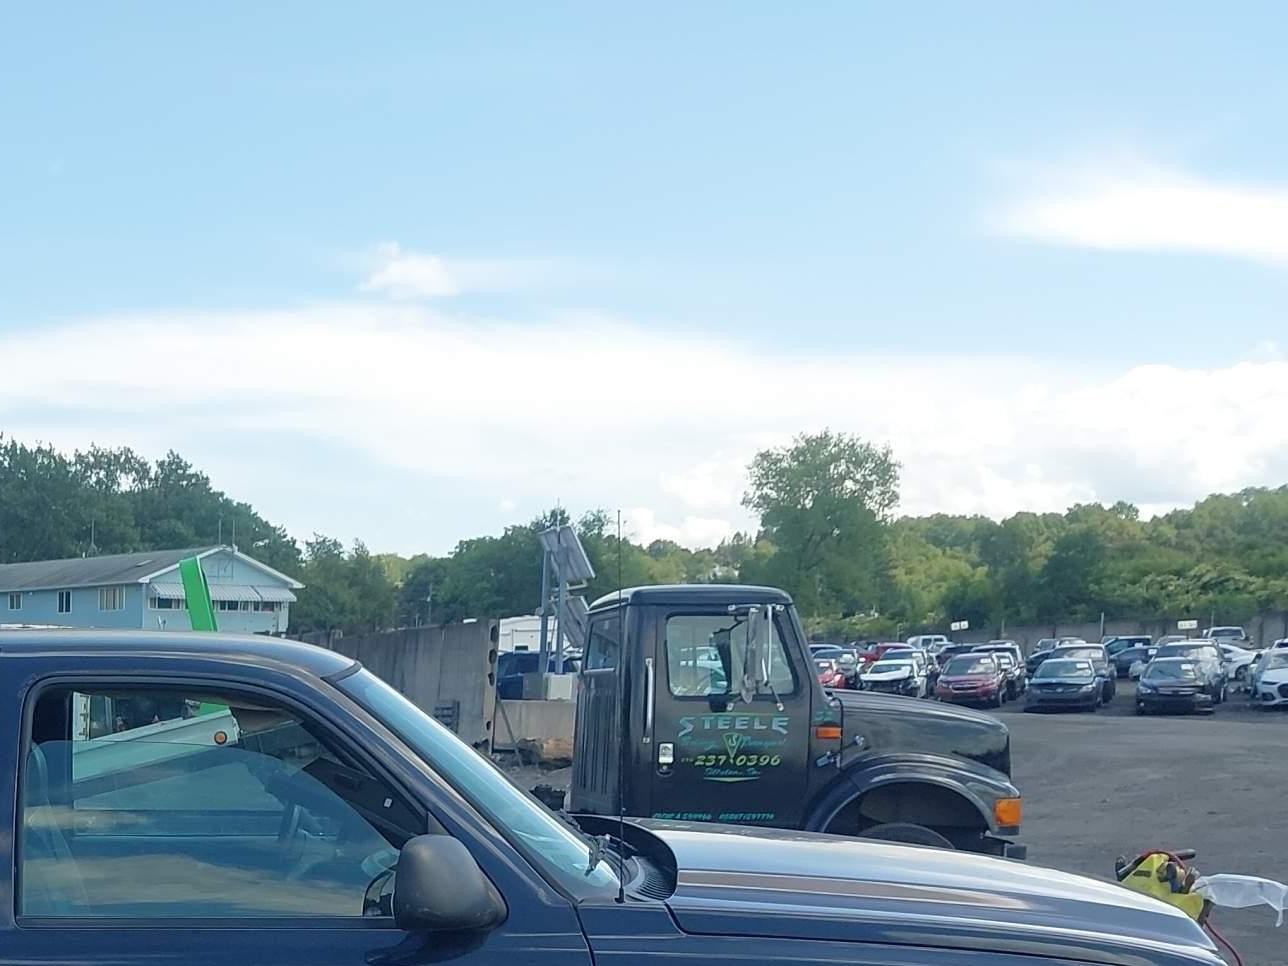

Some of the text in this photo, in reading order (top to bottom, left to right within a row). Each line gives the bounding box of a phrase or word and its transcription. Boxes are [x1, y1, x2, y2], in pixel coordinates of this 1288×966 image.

[678, 717, 789, 737] STEELE
[694, 755, 726, 766] 237
[736, 755, 781, 766] 0396
